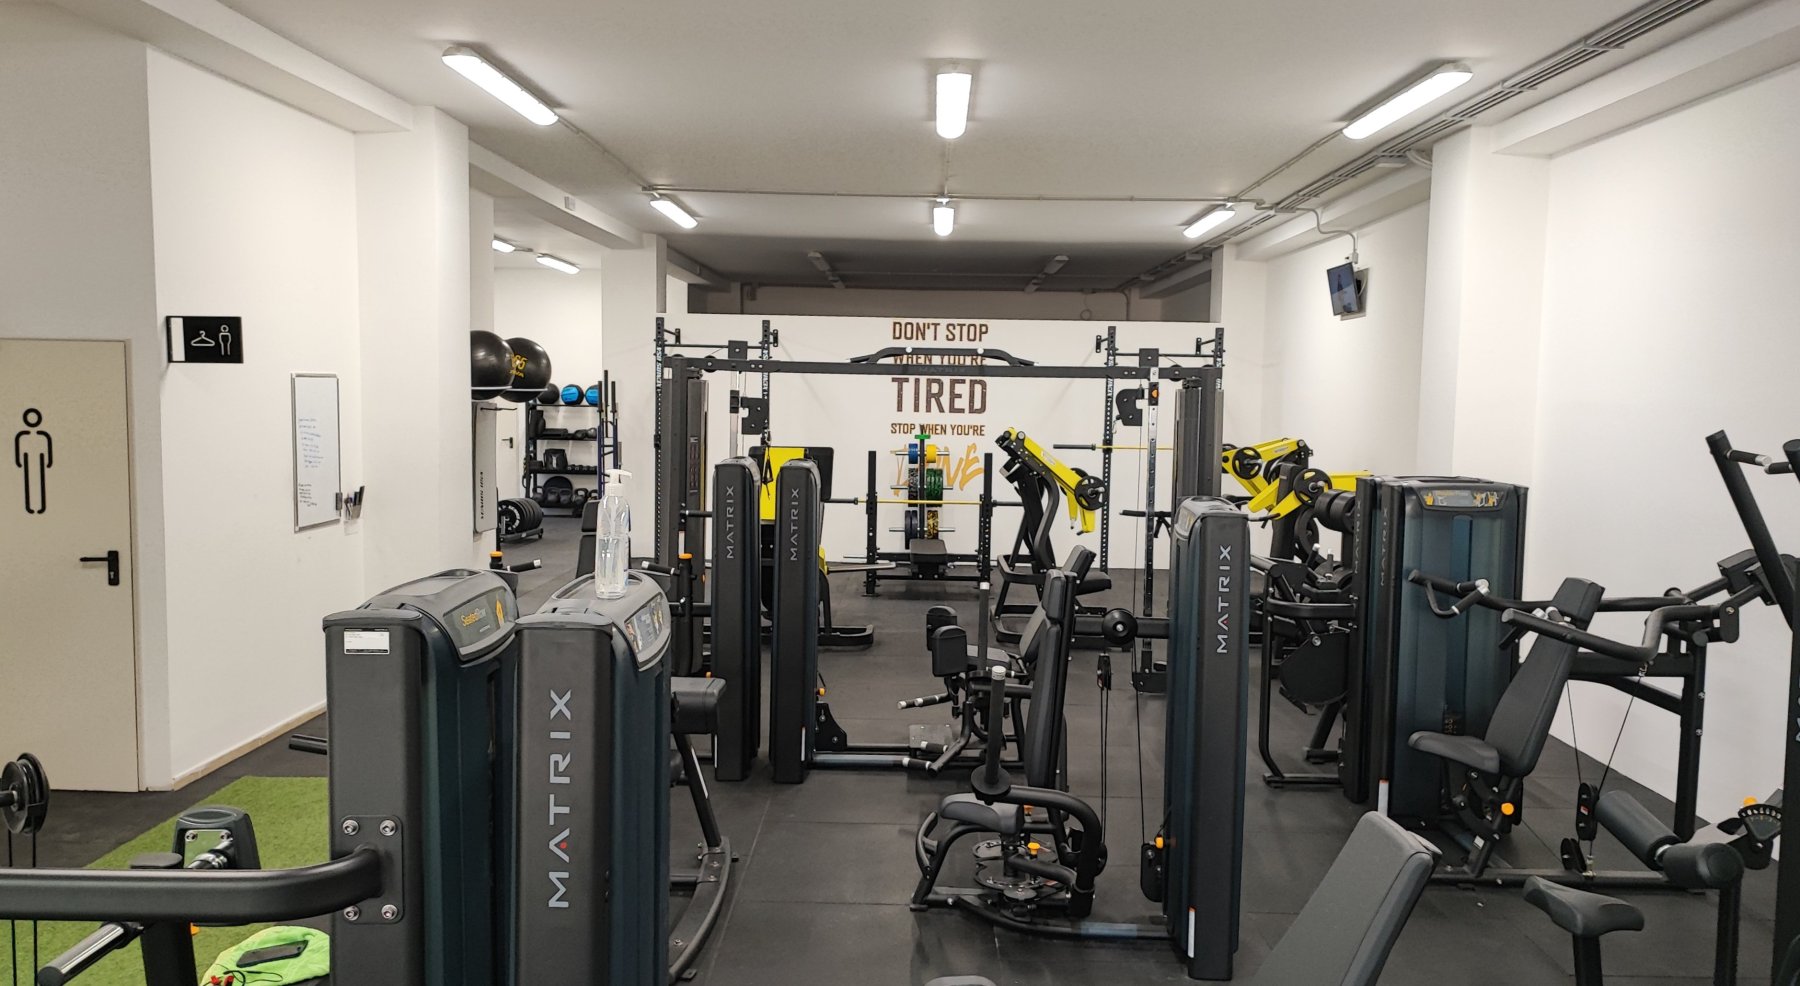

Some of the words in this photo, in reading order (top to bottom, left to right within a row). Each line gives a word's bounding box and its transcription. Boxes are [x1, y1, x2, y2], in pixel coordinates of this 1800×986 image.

[892, 321, 940, 341] DON'T
[945, 323, 989, 342] STOP
[891, 377, 987, 414] TIRED
[890, 423, 916, 434] STOP
[919, 424, 947, 435] WHEN
[950, 425, 986, 437] YOU'RE
[790, 488, 799, 561] MATRIX
[1217, 545, 1232, 653] MATRIX
[548, 689, 572, 908] MATRIX
